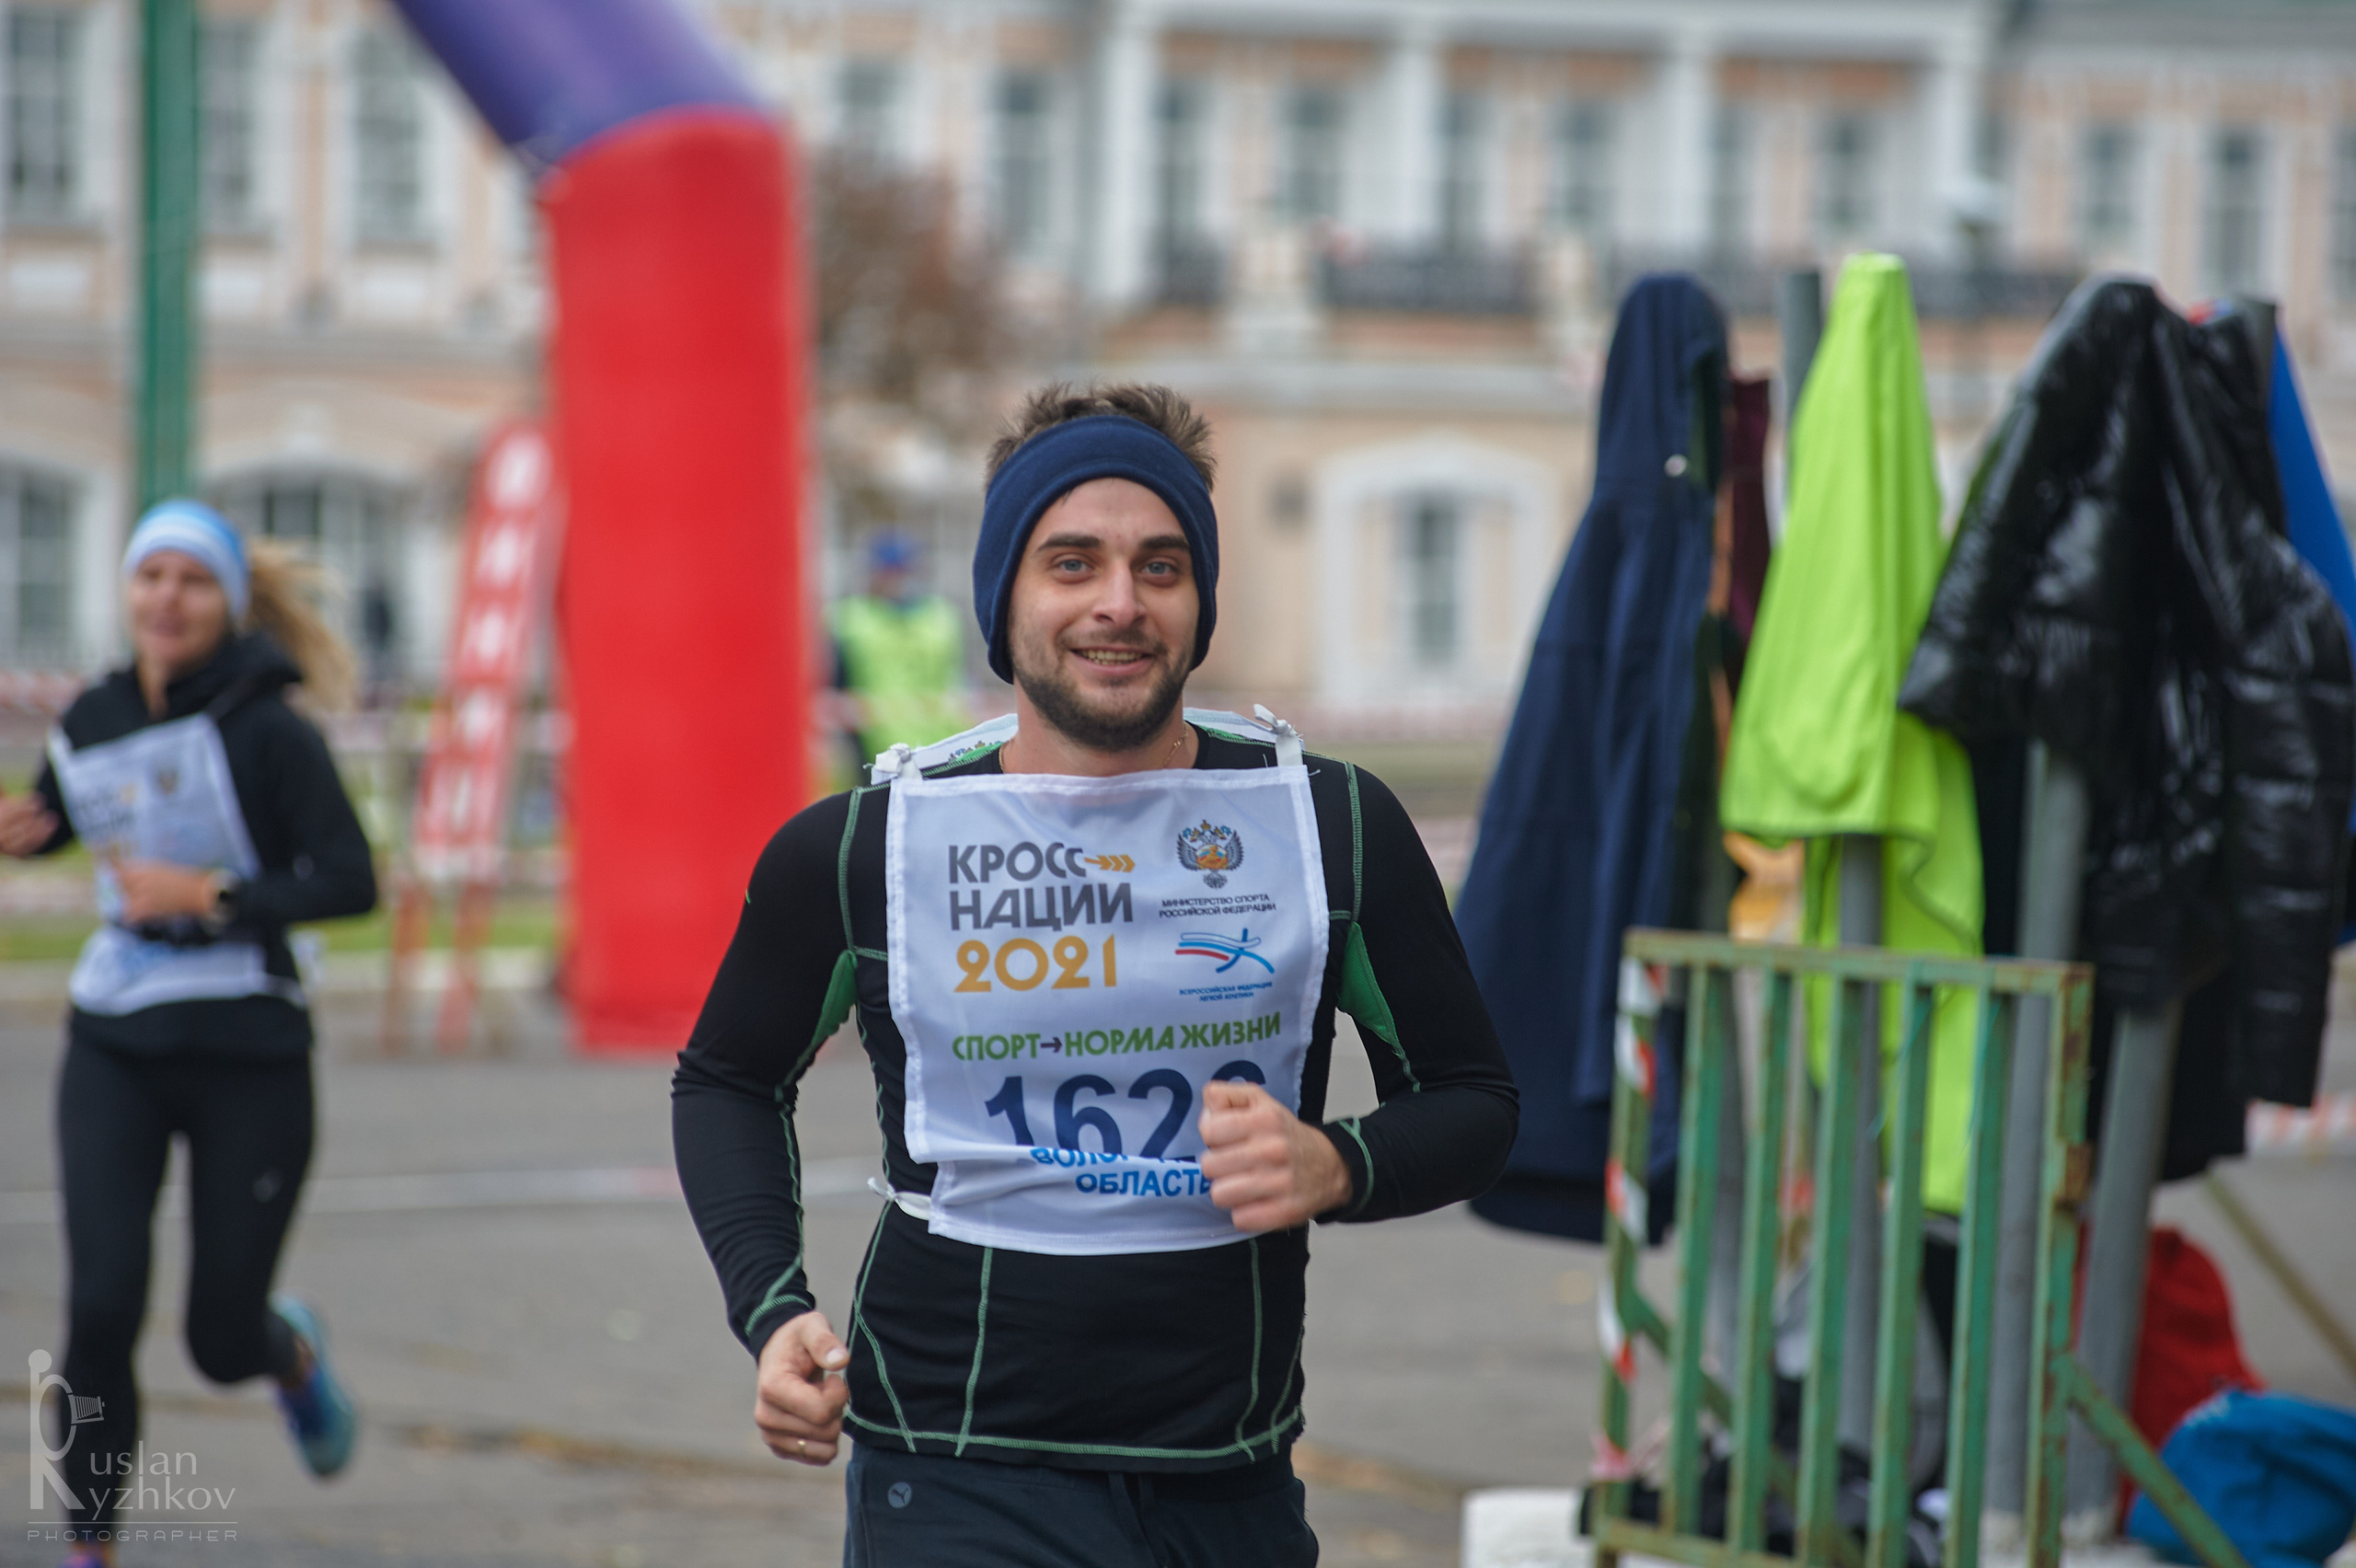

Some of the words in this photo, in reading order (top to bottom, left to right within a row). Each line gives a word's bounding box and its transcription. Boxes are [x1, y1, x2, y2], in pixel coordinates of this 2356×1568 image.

[948, 841, 1087, 884] КРОСС
[949, 882, 1134, 932] НАЦИИ
[1159, 905, 1221, 918] РОССИЙСКОЙ
[1222, 903, 1276, 915] ФЕДЕРАЦИИ
[1161, 896, 1233, 907] МИНИСТЕРСТВО
[1234, 894, 1270, 904] СПОРТА
[953, 933, 1117, 993] 2021
[952, 1032, 1042, 1062] СПОРТ
[1064, 1025, 1174, 1057] НОРМА
[1180, 1011, 1282, 1049] ЖИЗНИ
